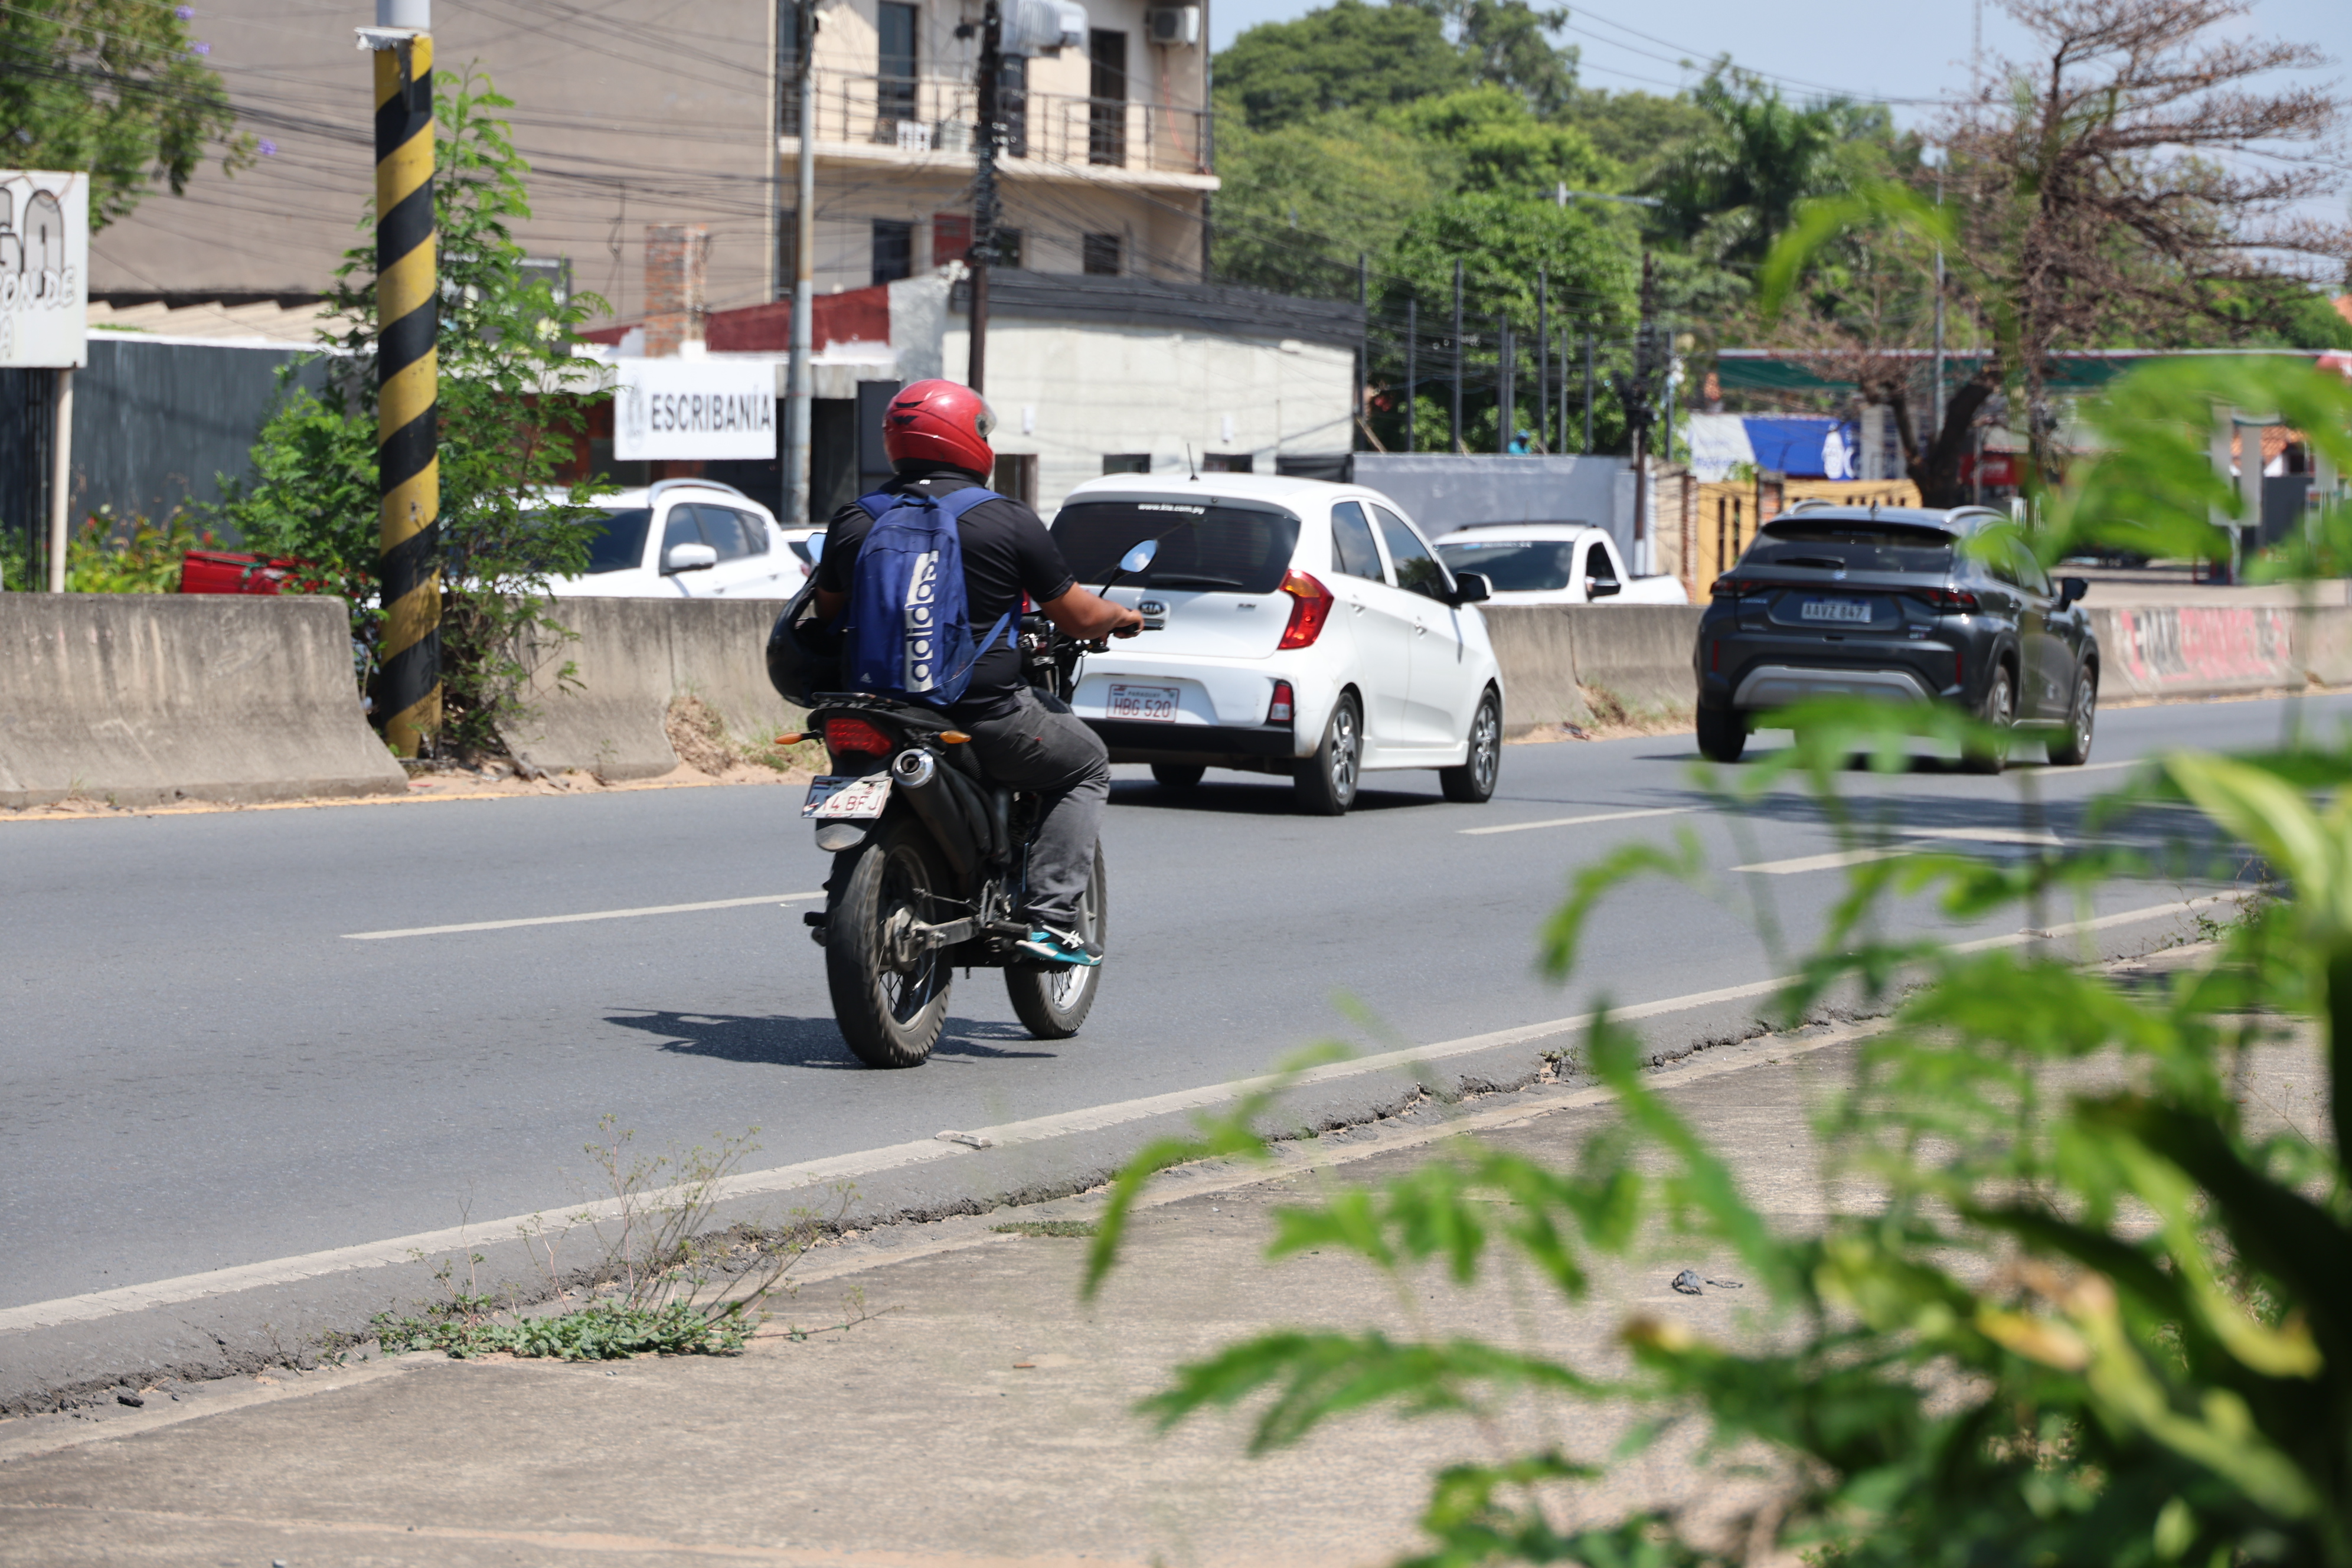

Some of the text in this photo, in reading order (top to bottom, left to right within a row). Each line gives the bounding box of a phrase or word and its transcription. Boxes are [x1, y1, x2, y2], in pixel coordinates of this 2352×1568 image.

[0, 267, 76, 311] ON DE
[1138, 503, 1206, 515] www.kia.com.py
[1140, 603, 1162, 614] KIA
[905, 555, 937, 688] adidas
[1113, 698, 1171, 717] HBG 520
